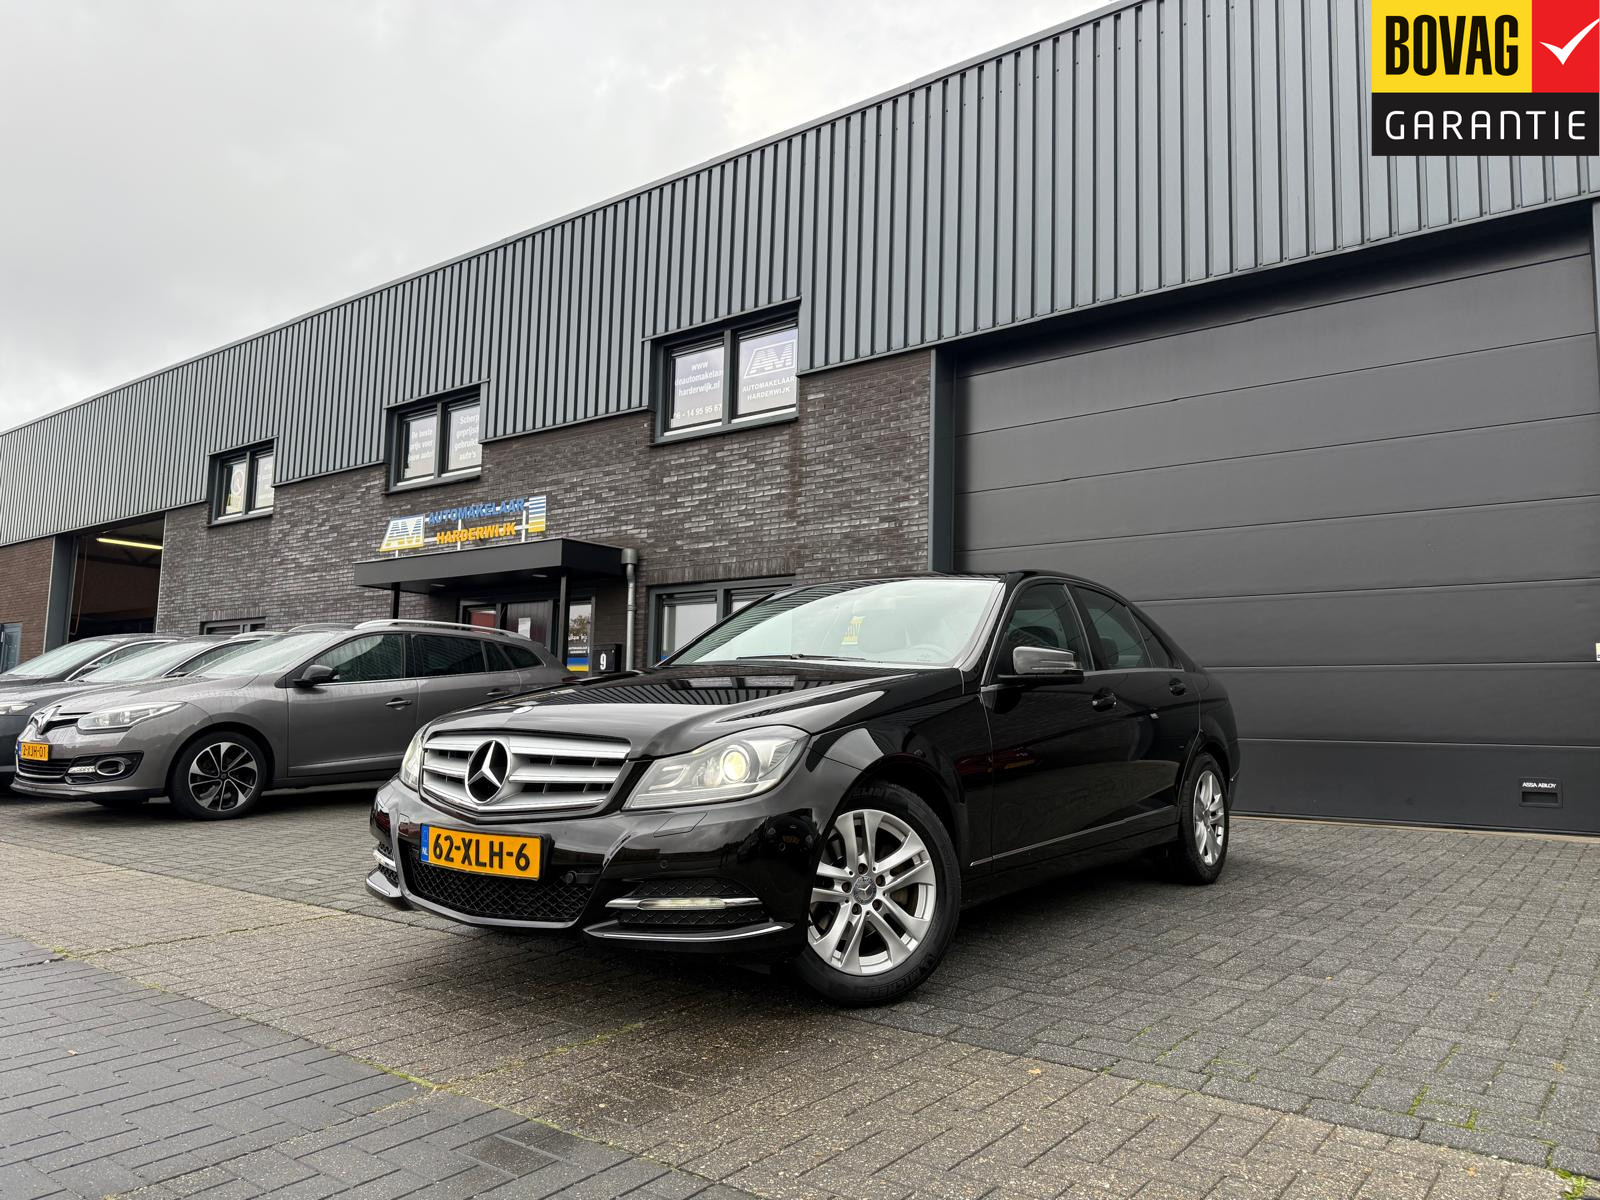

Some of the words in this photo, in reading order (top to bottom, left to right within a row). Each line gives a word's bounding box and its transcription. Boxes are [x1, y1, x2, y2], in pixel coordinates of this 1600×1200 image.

[692, 360, 708, 370] www
[742, 375, 796, 392] AUTOMAKELAAR
[747, 386, 790, 401] HARDERWIJK
[428, 499, 525, 525] AUTOMAKELAAR
[436, 521, 516, 544] HARDERWIJK
[600, 653, 607, 670] 9
[421, 847, 428, 856] NL
[433, 833, 530, 872] 62-XLH-6
